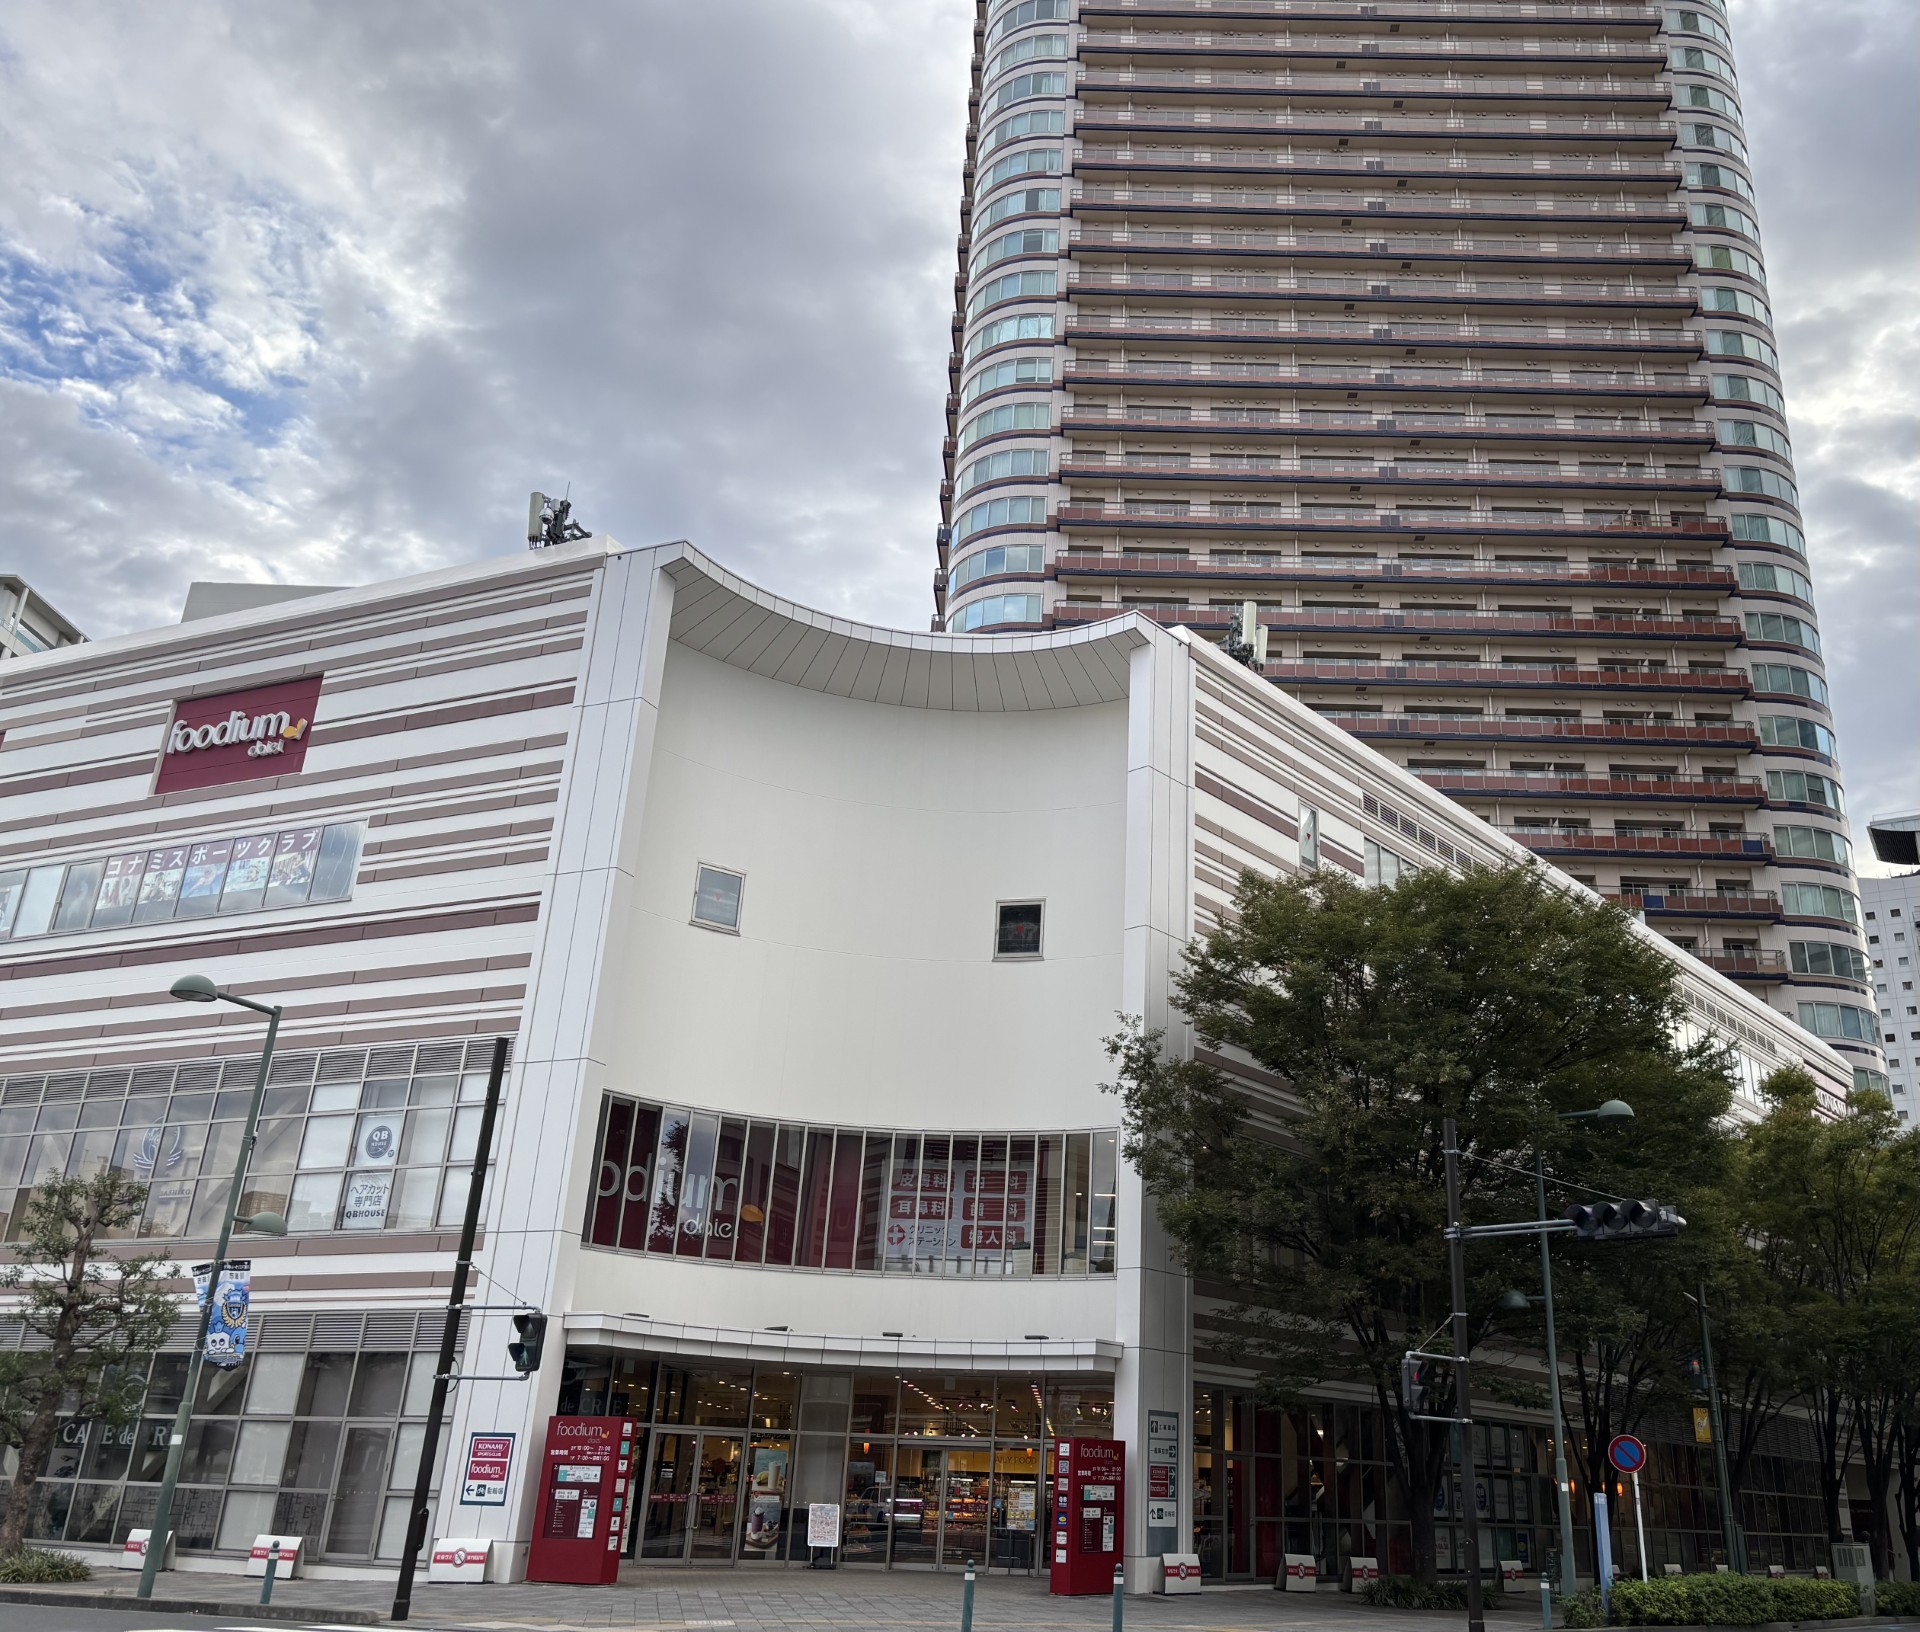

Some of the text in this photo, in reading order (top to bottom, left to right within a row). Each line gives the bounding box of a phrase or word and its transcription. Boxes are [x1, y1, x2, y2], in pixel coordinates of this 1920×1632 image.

[167, 711, 290, 754] foodium
[248, 739, 285, 758] daiei
[107, 829, 319, 876] コナミスポーツクラブ
[372, 1130, 389, 1141] QB
[350, 1183, 389, 1195] ヘアカット
[354, 1195, 383, 1207] 専門店
[345, 1208, 385, 1219] QBHOUSE
[118, 1424, 135, 1445] de
[557, 1421, 602, 1436] foodium
[1081, 1444, 1114, 1458] foodium
[471, 1463, 501, 1474] foodium
[1169, 1484, 1175, 1496] P
